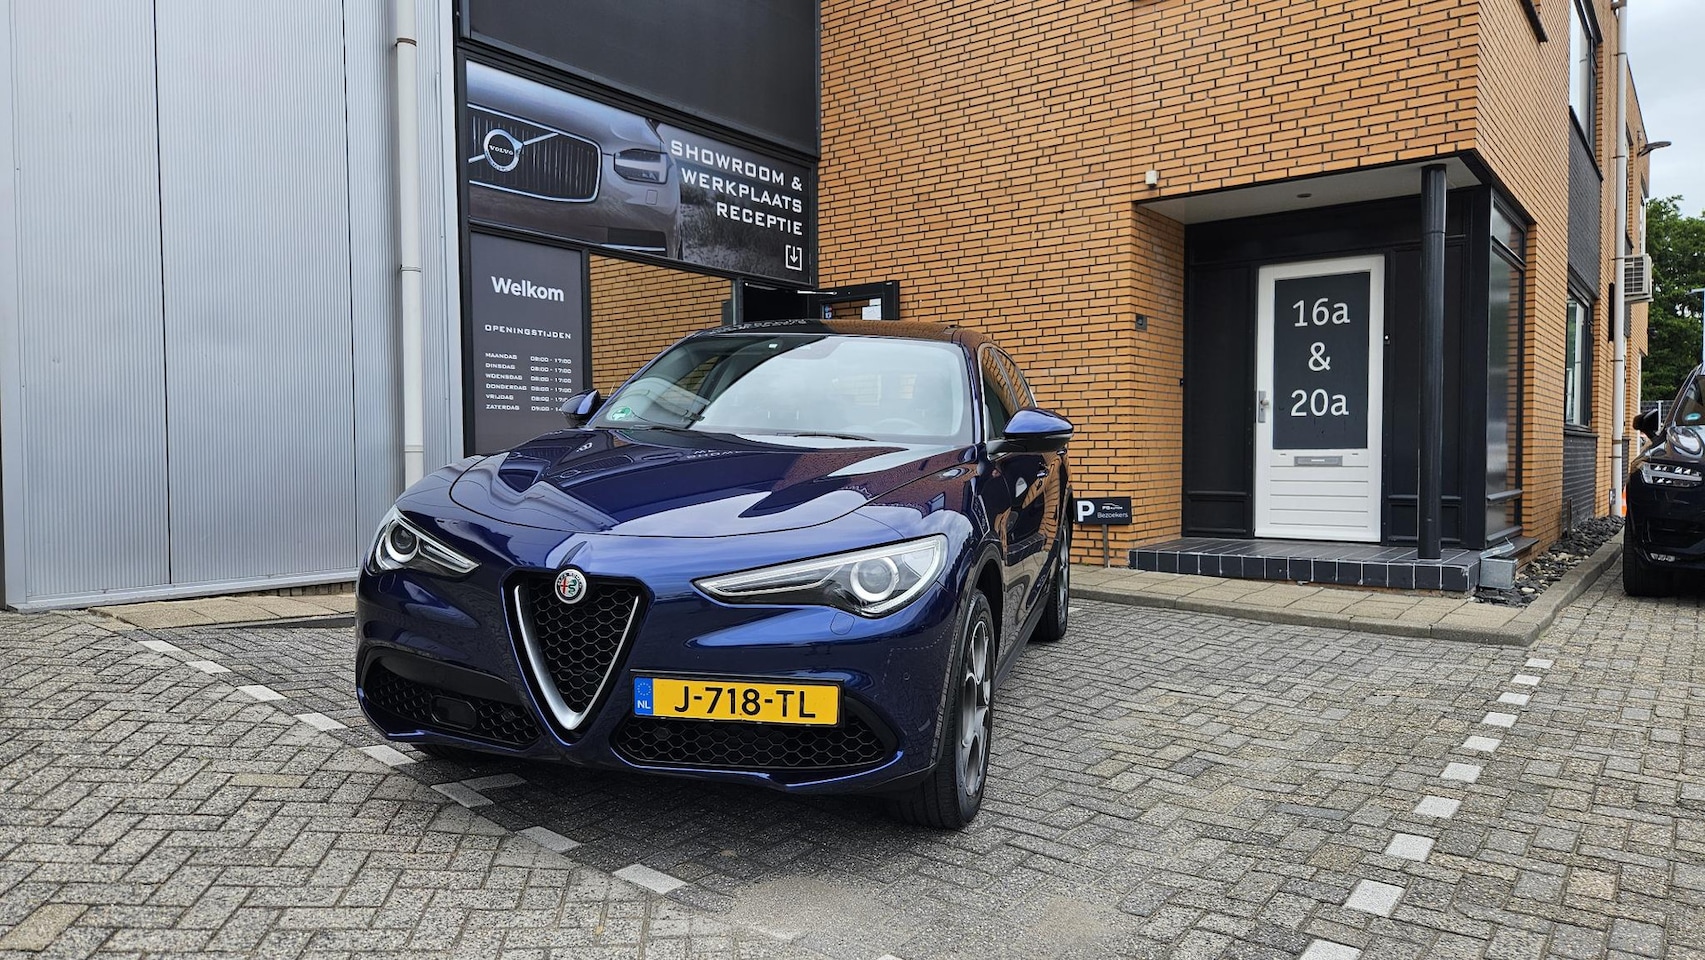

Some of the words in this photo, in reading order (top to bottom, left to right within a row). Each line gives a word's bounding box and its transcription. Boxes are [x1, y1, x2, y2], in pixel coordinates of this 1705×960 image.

[489, 145, 514, 156] VOLVO
[671, 140, 784, 186] SHOWROOM
[791, 176, 803, 191] &
[681, 168, 802, 213] WERKPLAATS
[716, 202, 803, 235] RECEPTIE
[490, 275, 565, 302] Welkom
[1292, 297, 1351, 327] 16a
[484, 324, 572, 340] OPENINGSTIJDEN
[485, 352, 518, 360] MAANDAG
[1308, 341, 1331, 372] &
[485, 362, 516, 370] DINSDAG
[485, 373, 523, 381] WOENSDAG
[485, 383, 527, 391] DONDERDAG
[485, 393, 514, 401] VRIJDAG
[1290, 388, 1350, 417] 20a
[1077, 500, 1095, 522] P
[1097, 511, 1129, 519] Bezoekers
[637, 700, 651, 710] NL
[674, 685, 816, 718] J-718-TL
